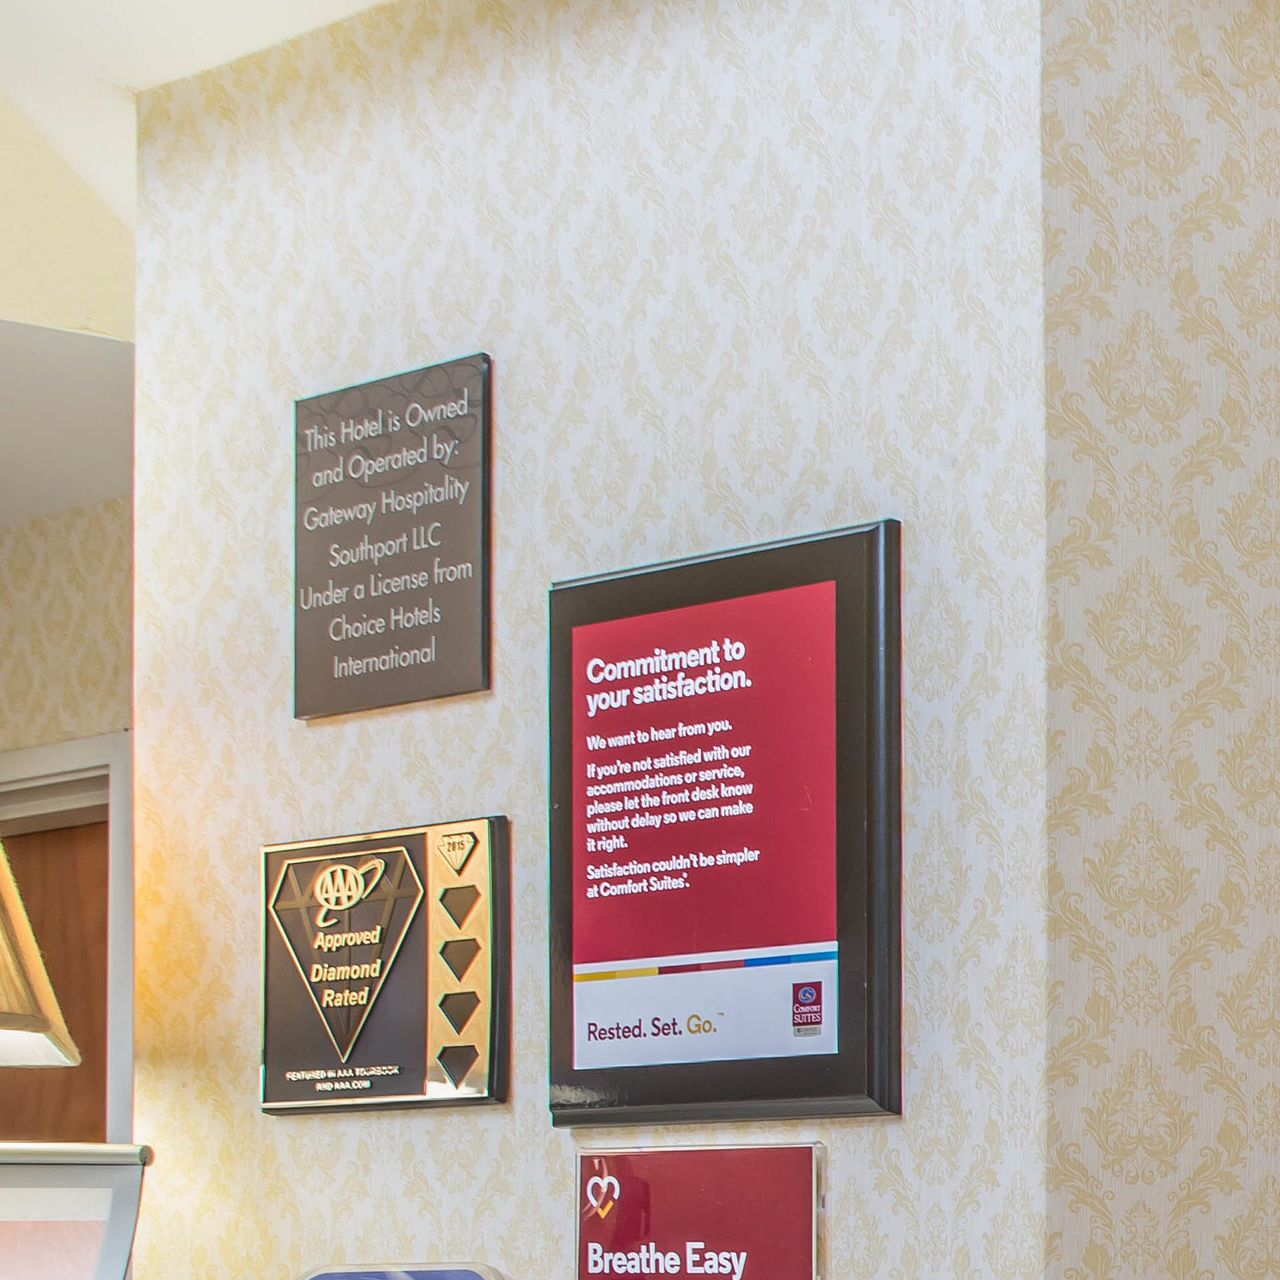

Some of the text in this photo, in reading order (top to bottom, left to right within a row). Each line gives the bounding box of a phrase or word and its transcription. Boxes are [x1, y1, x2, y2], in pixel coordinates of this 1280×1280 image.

[304, 388, 469, 453] This Hotel is Owned
[312, 435, 459, 487] and Operated by:
[302, 474, 469, 532] Gateway Hospitality
[329, 522, 442, 568] Southport LLC
[300, 558, 473, 610] Under a License from
[329, 598, 441, 643] Choice Hotels
[333, 636, 436, 679] International
[586, 638, 746, 684] Commitment to
[586, 667, 752, 717] your satisfaction.
[586, 720, 732, 750] We want to hear from you.
[587, 746, 752, 779] If you're not satisfied with our
[587, 764, 745, 796] accommodations or service,
[587, 783, 753, 818] please let the front desk know
[587, 800, 753, 833] without delay so we can make
[446, 841, 466, 852] 2015
[587, 835, 628, 852] it right.
[587, 848, 760, 880] Satisfaction couldn't be simpler
[587, 879, 648, 898] at Comfort
[314, 926, 382, 952] Approved
[311, 960, 381, 982] Diamond
[322, 987, 369, 1008] Rated
[587, 1018, 647, 1041] Rested.
[651, 1016, 682, 1036] Set.
[794, 1013, 821, 1023] SUITES
[587, 1242, 747, 1280] Breathe Easy
